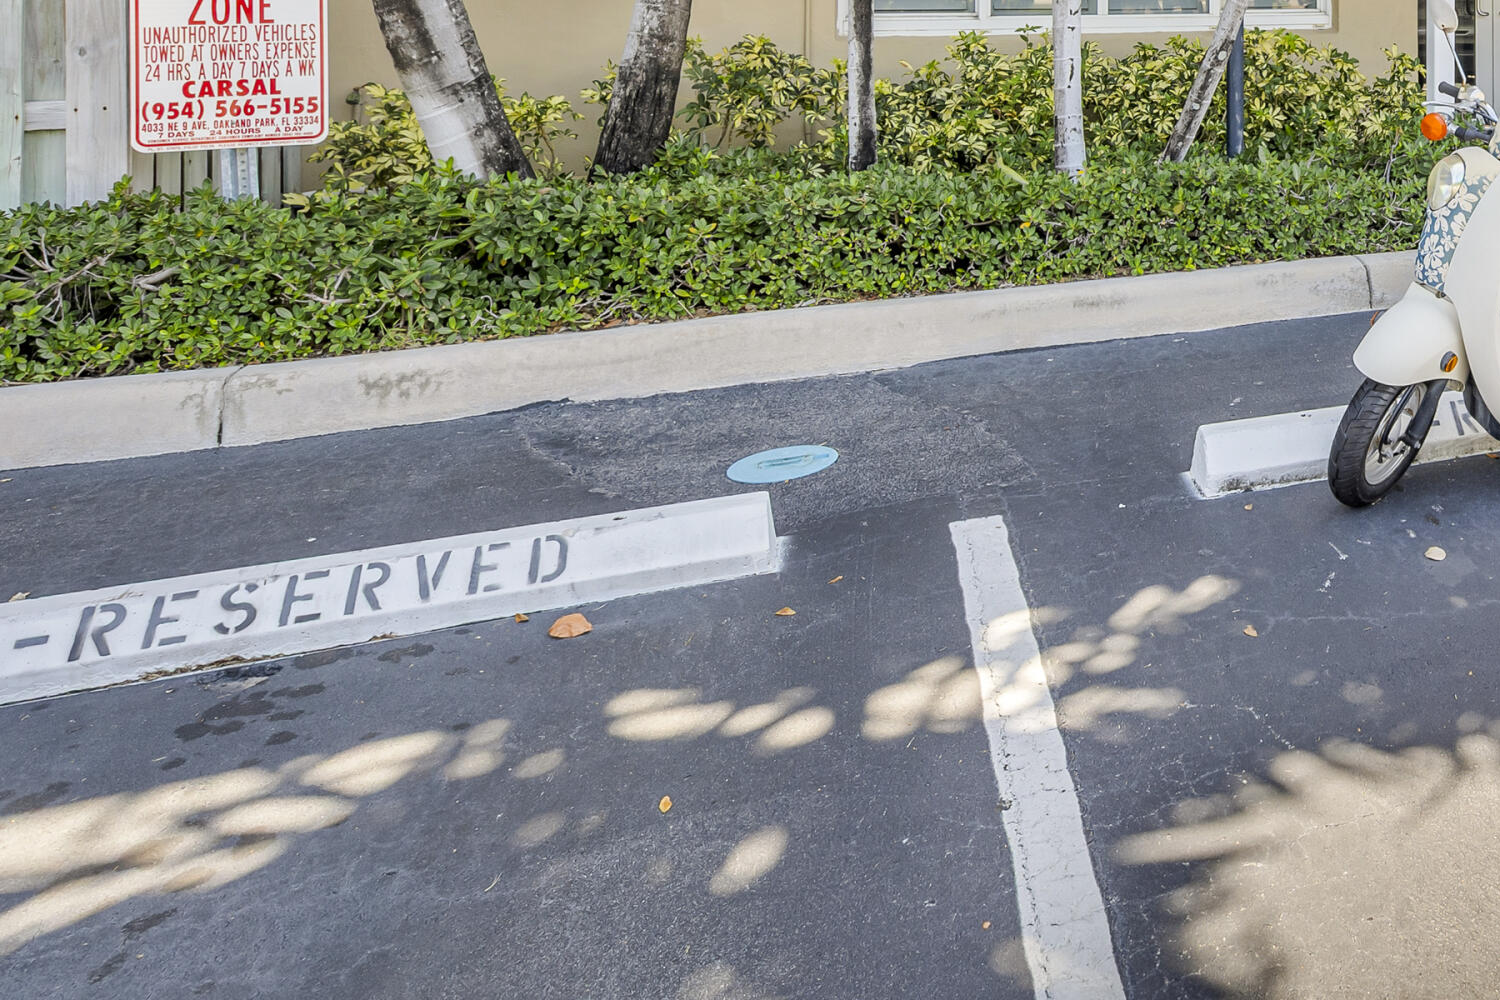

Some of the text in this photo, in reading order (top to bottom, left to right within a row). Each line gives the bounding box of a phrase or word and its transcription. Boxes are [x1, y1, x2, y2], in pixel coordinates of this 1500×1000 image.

[143, 23, 317, 45] UNAUTHORIZED VEHICLES
[144, 41, 317, 63] TOWED AT OWNERS EXPENSE
[145, 59, 315, 82] 24 HRS A DAY 7 DAYS A WK
[182, 78, 282, 98] CARSAL
[142, 96, 319, 122] (954) 566-5155
[141, 115, 319, 133] 4033 NE 9 AVE, OAKLAND PARK, FL 33334
[226, 127, 261, 135] HOURS
